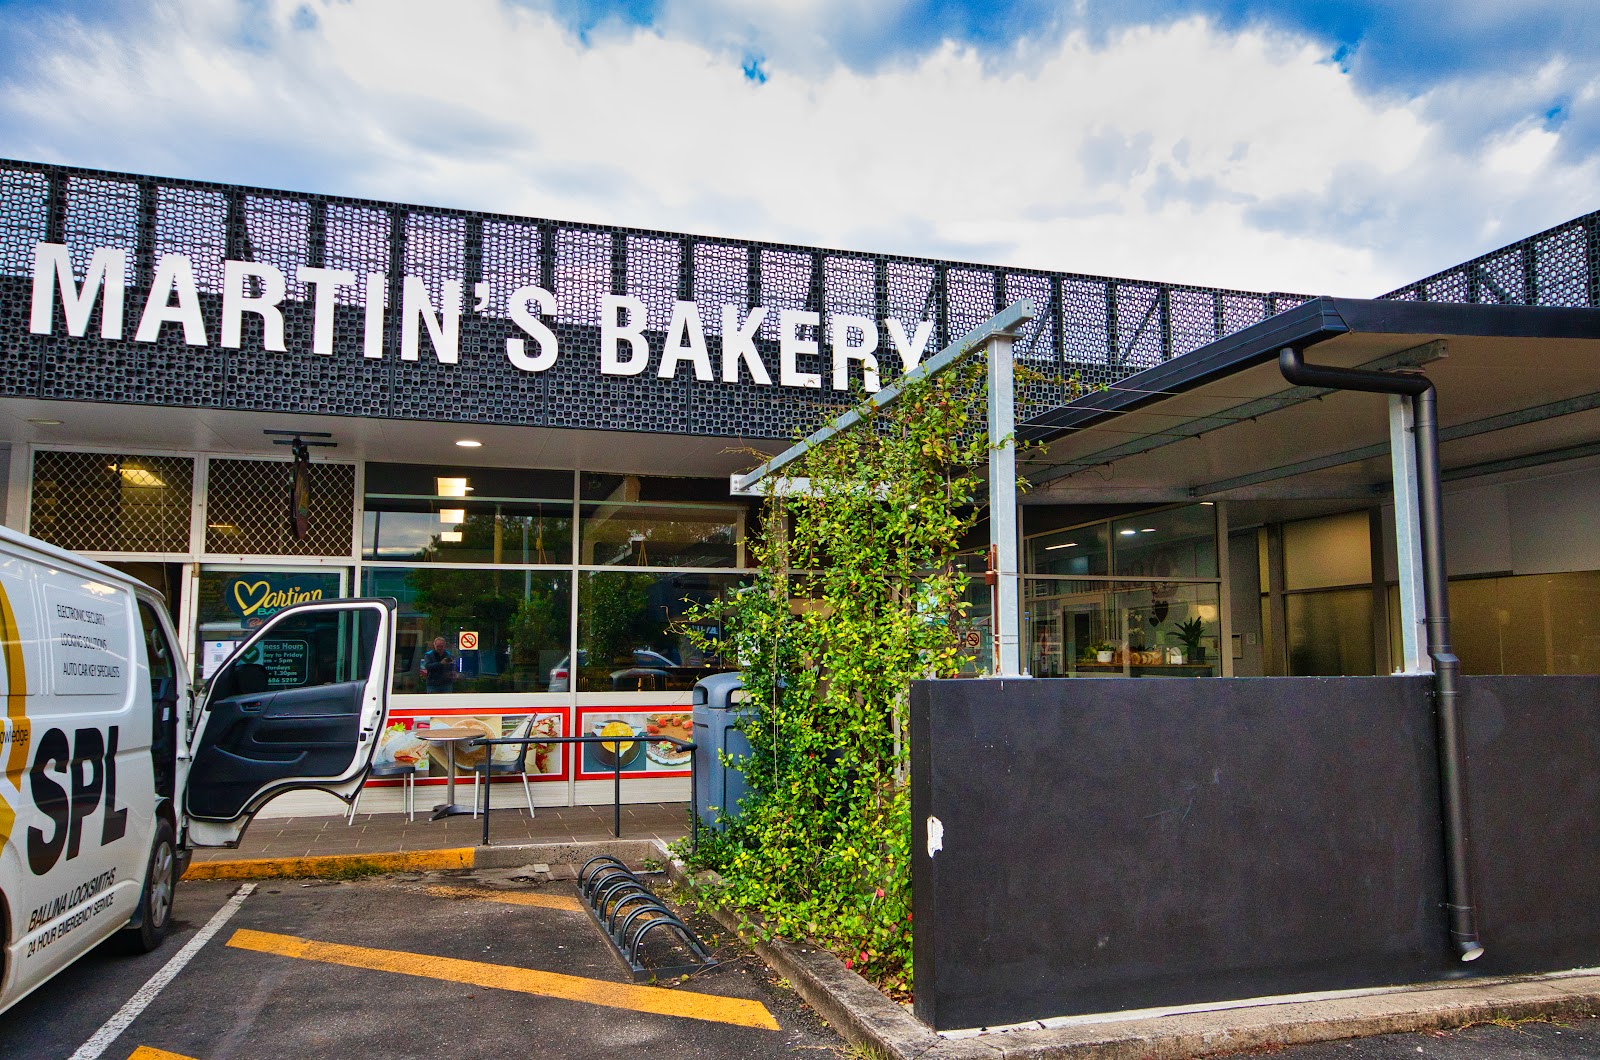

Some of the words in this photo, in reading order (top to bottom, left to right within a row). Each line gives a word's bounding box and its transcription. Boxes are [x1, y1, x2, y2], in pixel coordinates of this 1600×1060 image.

[30, 241, 558, 373] MARTIN'S
[600, 293, 934, 393] BAKERY
[57, 604, 84, 621] ELECTRONIC
[84, 610, 106, 626] SECURITY
[60, 632, 83, 648] LOCKING
[83, 635, 108, 651] SOLUTIONS
[63, 662, 78, 676] AUTO
[78, 663, 89, 677] CAR
[89, 664, 97, 677] KEY
[97, 664, 120, 678] SPECIALISTS
[27, 726, 128, 876] SPL
[27, 939, 36, 958] 24
[37, 926, 57, 952] HOUR
[58, 904, 94, 939] EMERGENCY
[93, 892, 115, 916] SERVICE
[28, 893, 68, 932] BALLINA
[68, 867, 116, 910] LOCKSMITHS
